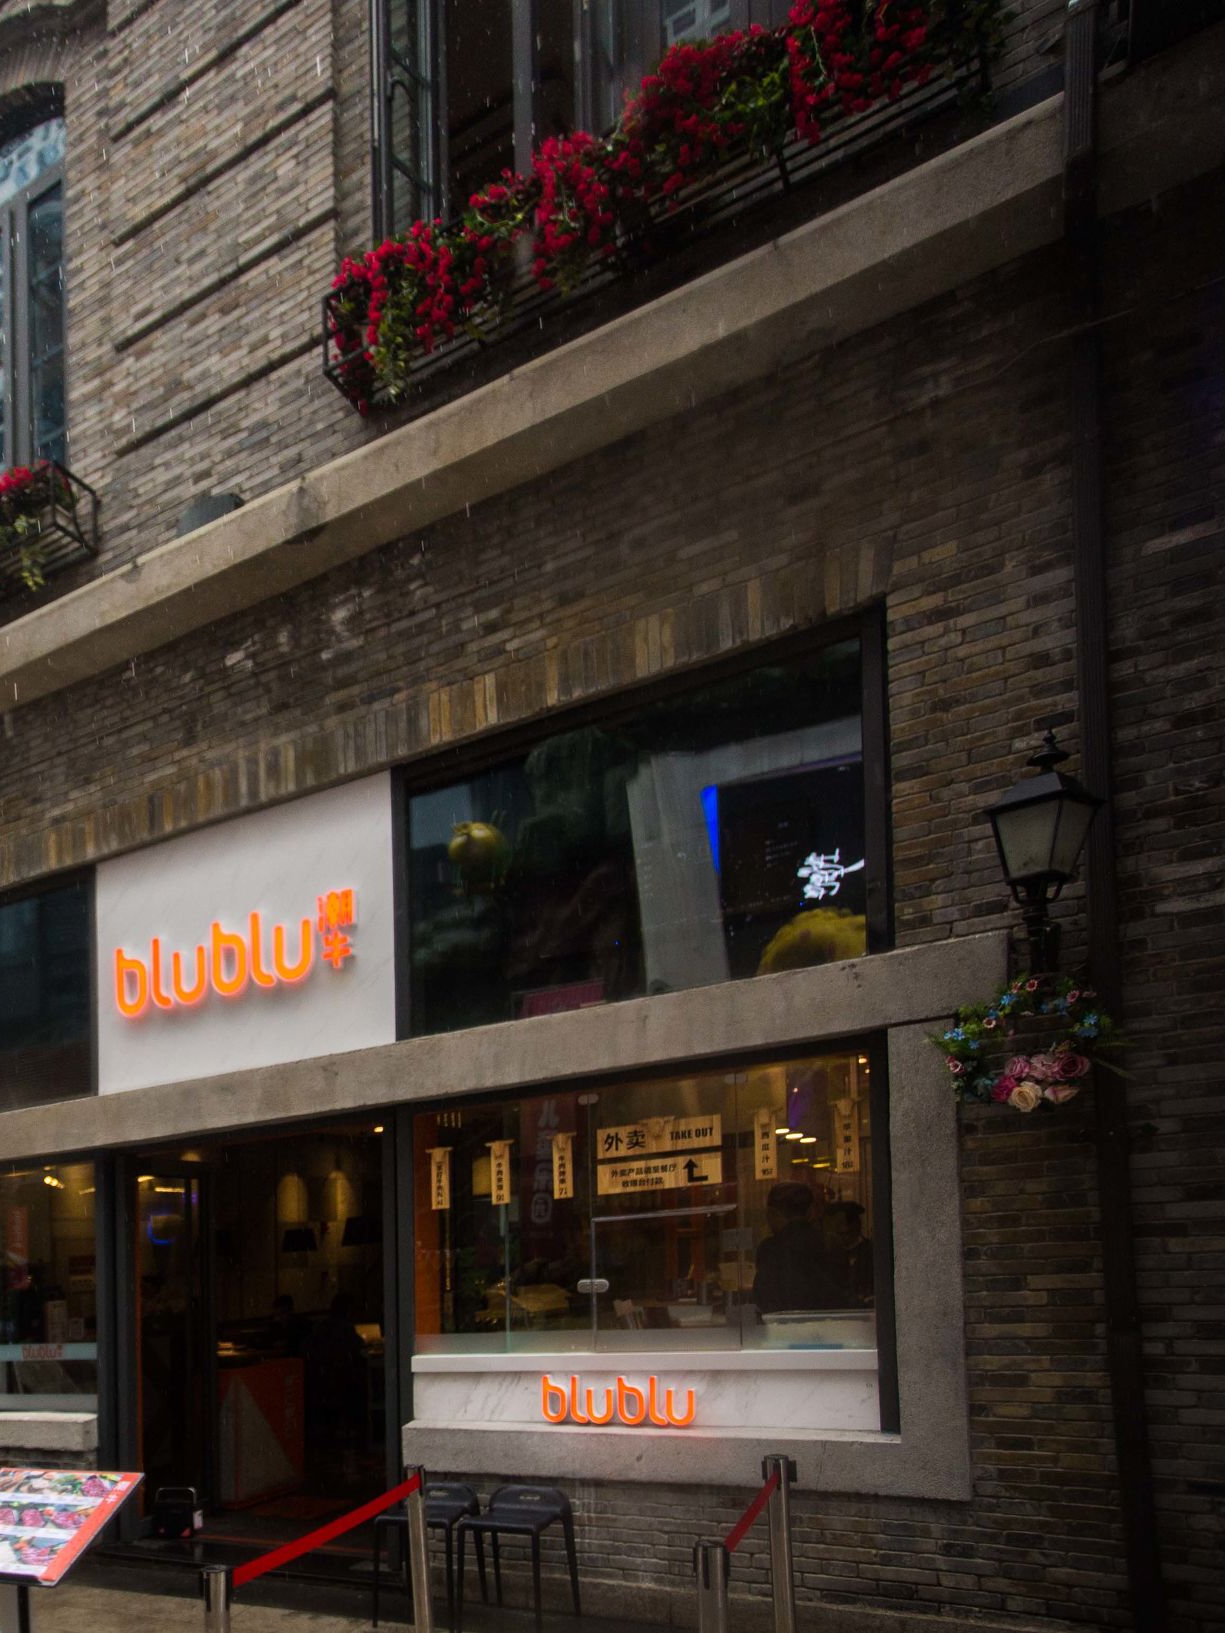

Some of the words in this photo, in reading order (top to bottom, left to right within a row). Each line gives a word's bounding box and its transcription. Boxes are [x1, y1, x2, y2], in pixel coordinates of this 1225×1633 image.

[114, 909, 314, 1019] blublu
[604, 1130, 646, 1152] 外卖
[670, 1130, 693, 1141] TAKE
[694, 1127, 714, 1138] OUT
[541, 1374, 697, 1426] blublu
